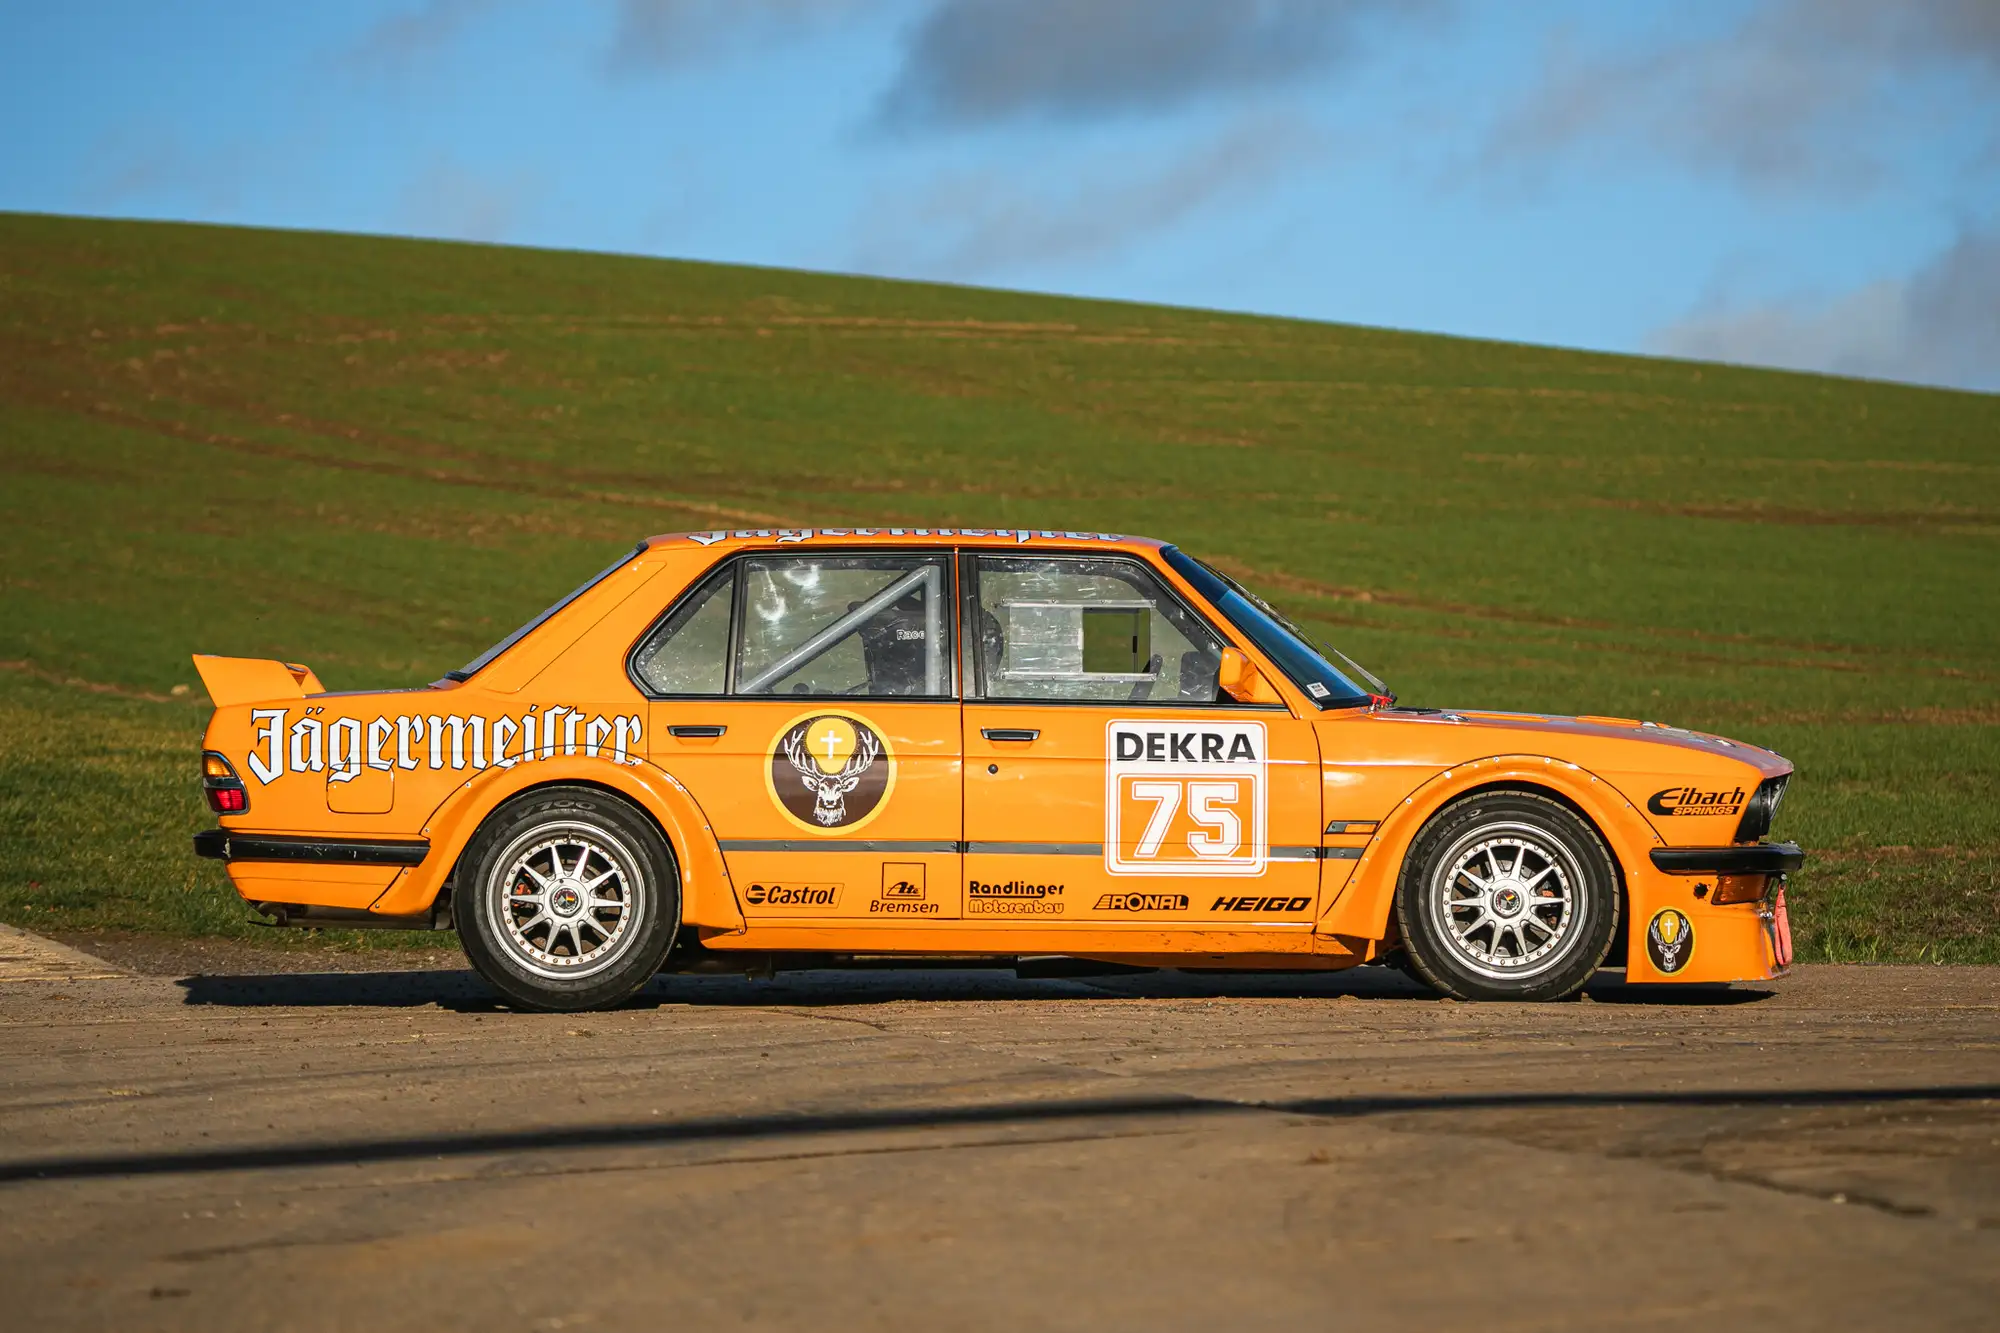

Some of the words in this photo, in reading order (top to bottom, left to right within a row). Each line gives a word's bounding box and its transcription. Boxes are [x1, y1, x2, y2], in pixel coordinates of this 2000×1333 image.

[1116, 732, 1257, 763] DEKRA
[1647, 786, 1746, 816] Eibach
[1672, 806, 1736, 815] SPRINGS
[1131, 781, 1241, 858] 75
[767, 885, 836, 905] Castrol
[969, 880, 1065, 898] Randlinger
[869, 900, 940, 914] Bremsen
[968, 899, 1064, 914] Motorenbau
[1108, 892, 1189, 912] RONAL
[1210, 897, 1312, 912] HEIGO
